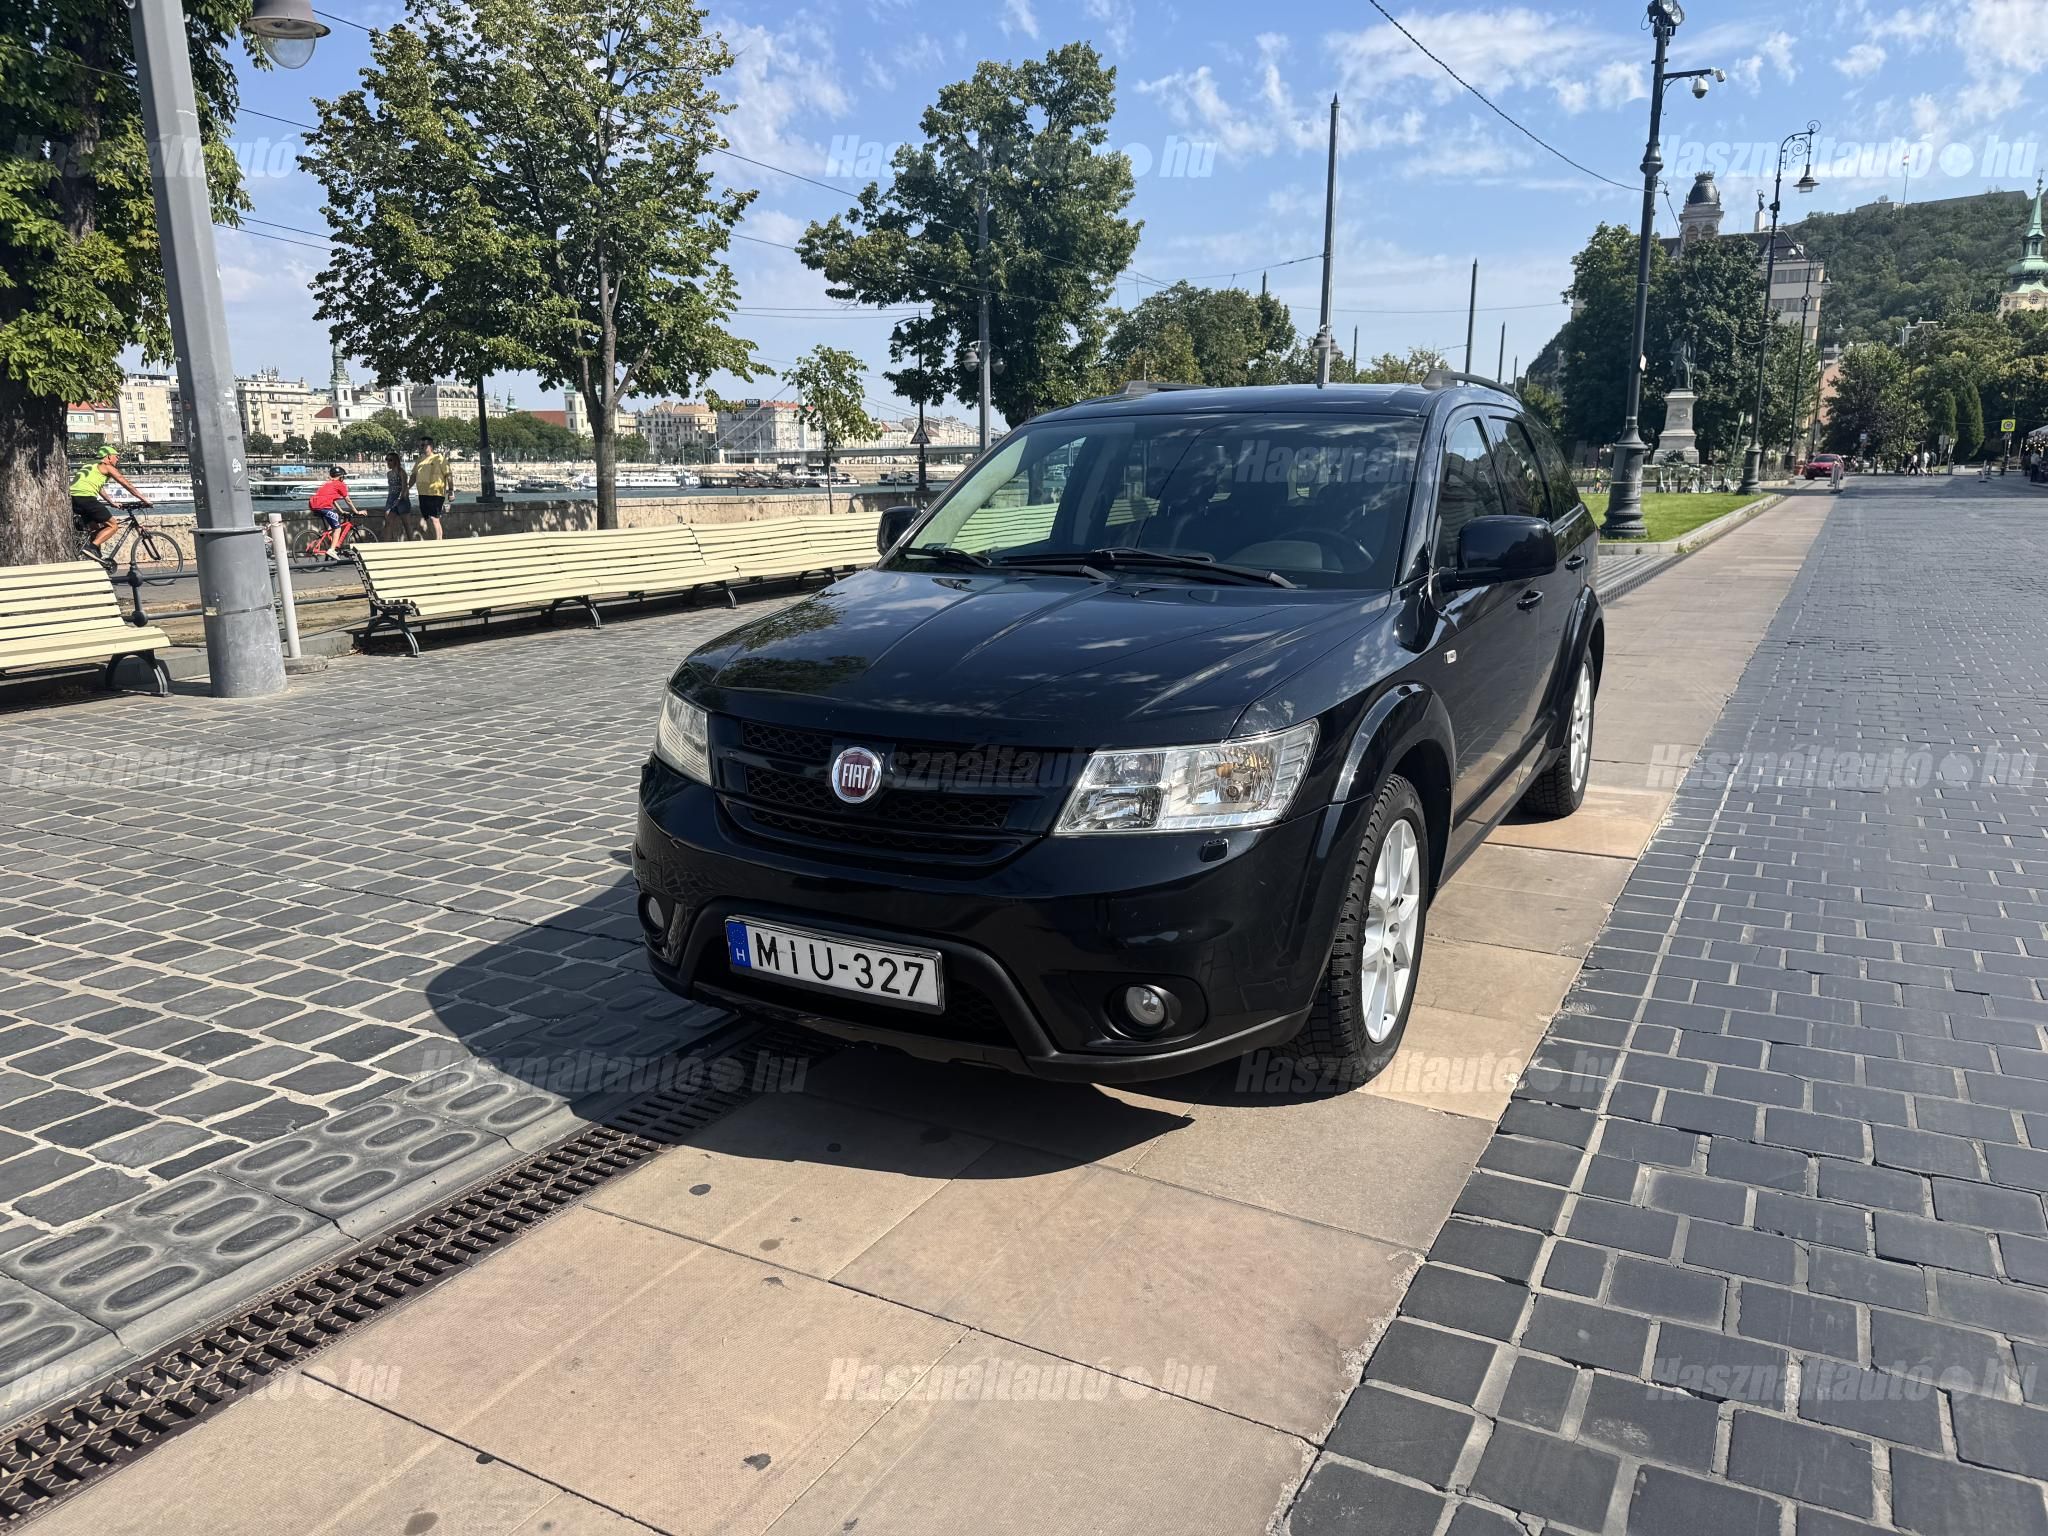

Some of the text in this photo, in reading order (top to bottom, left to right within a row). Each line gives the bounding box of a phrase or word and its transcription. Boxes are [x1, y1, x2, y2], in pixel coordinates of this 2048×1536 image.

[841, 763, 870, 789] FIAT
[736, 932, 925, 998] H MIU-327
